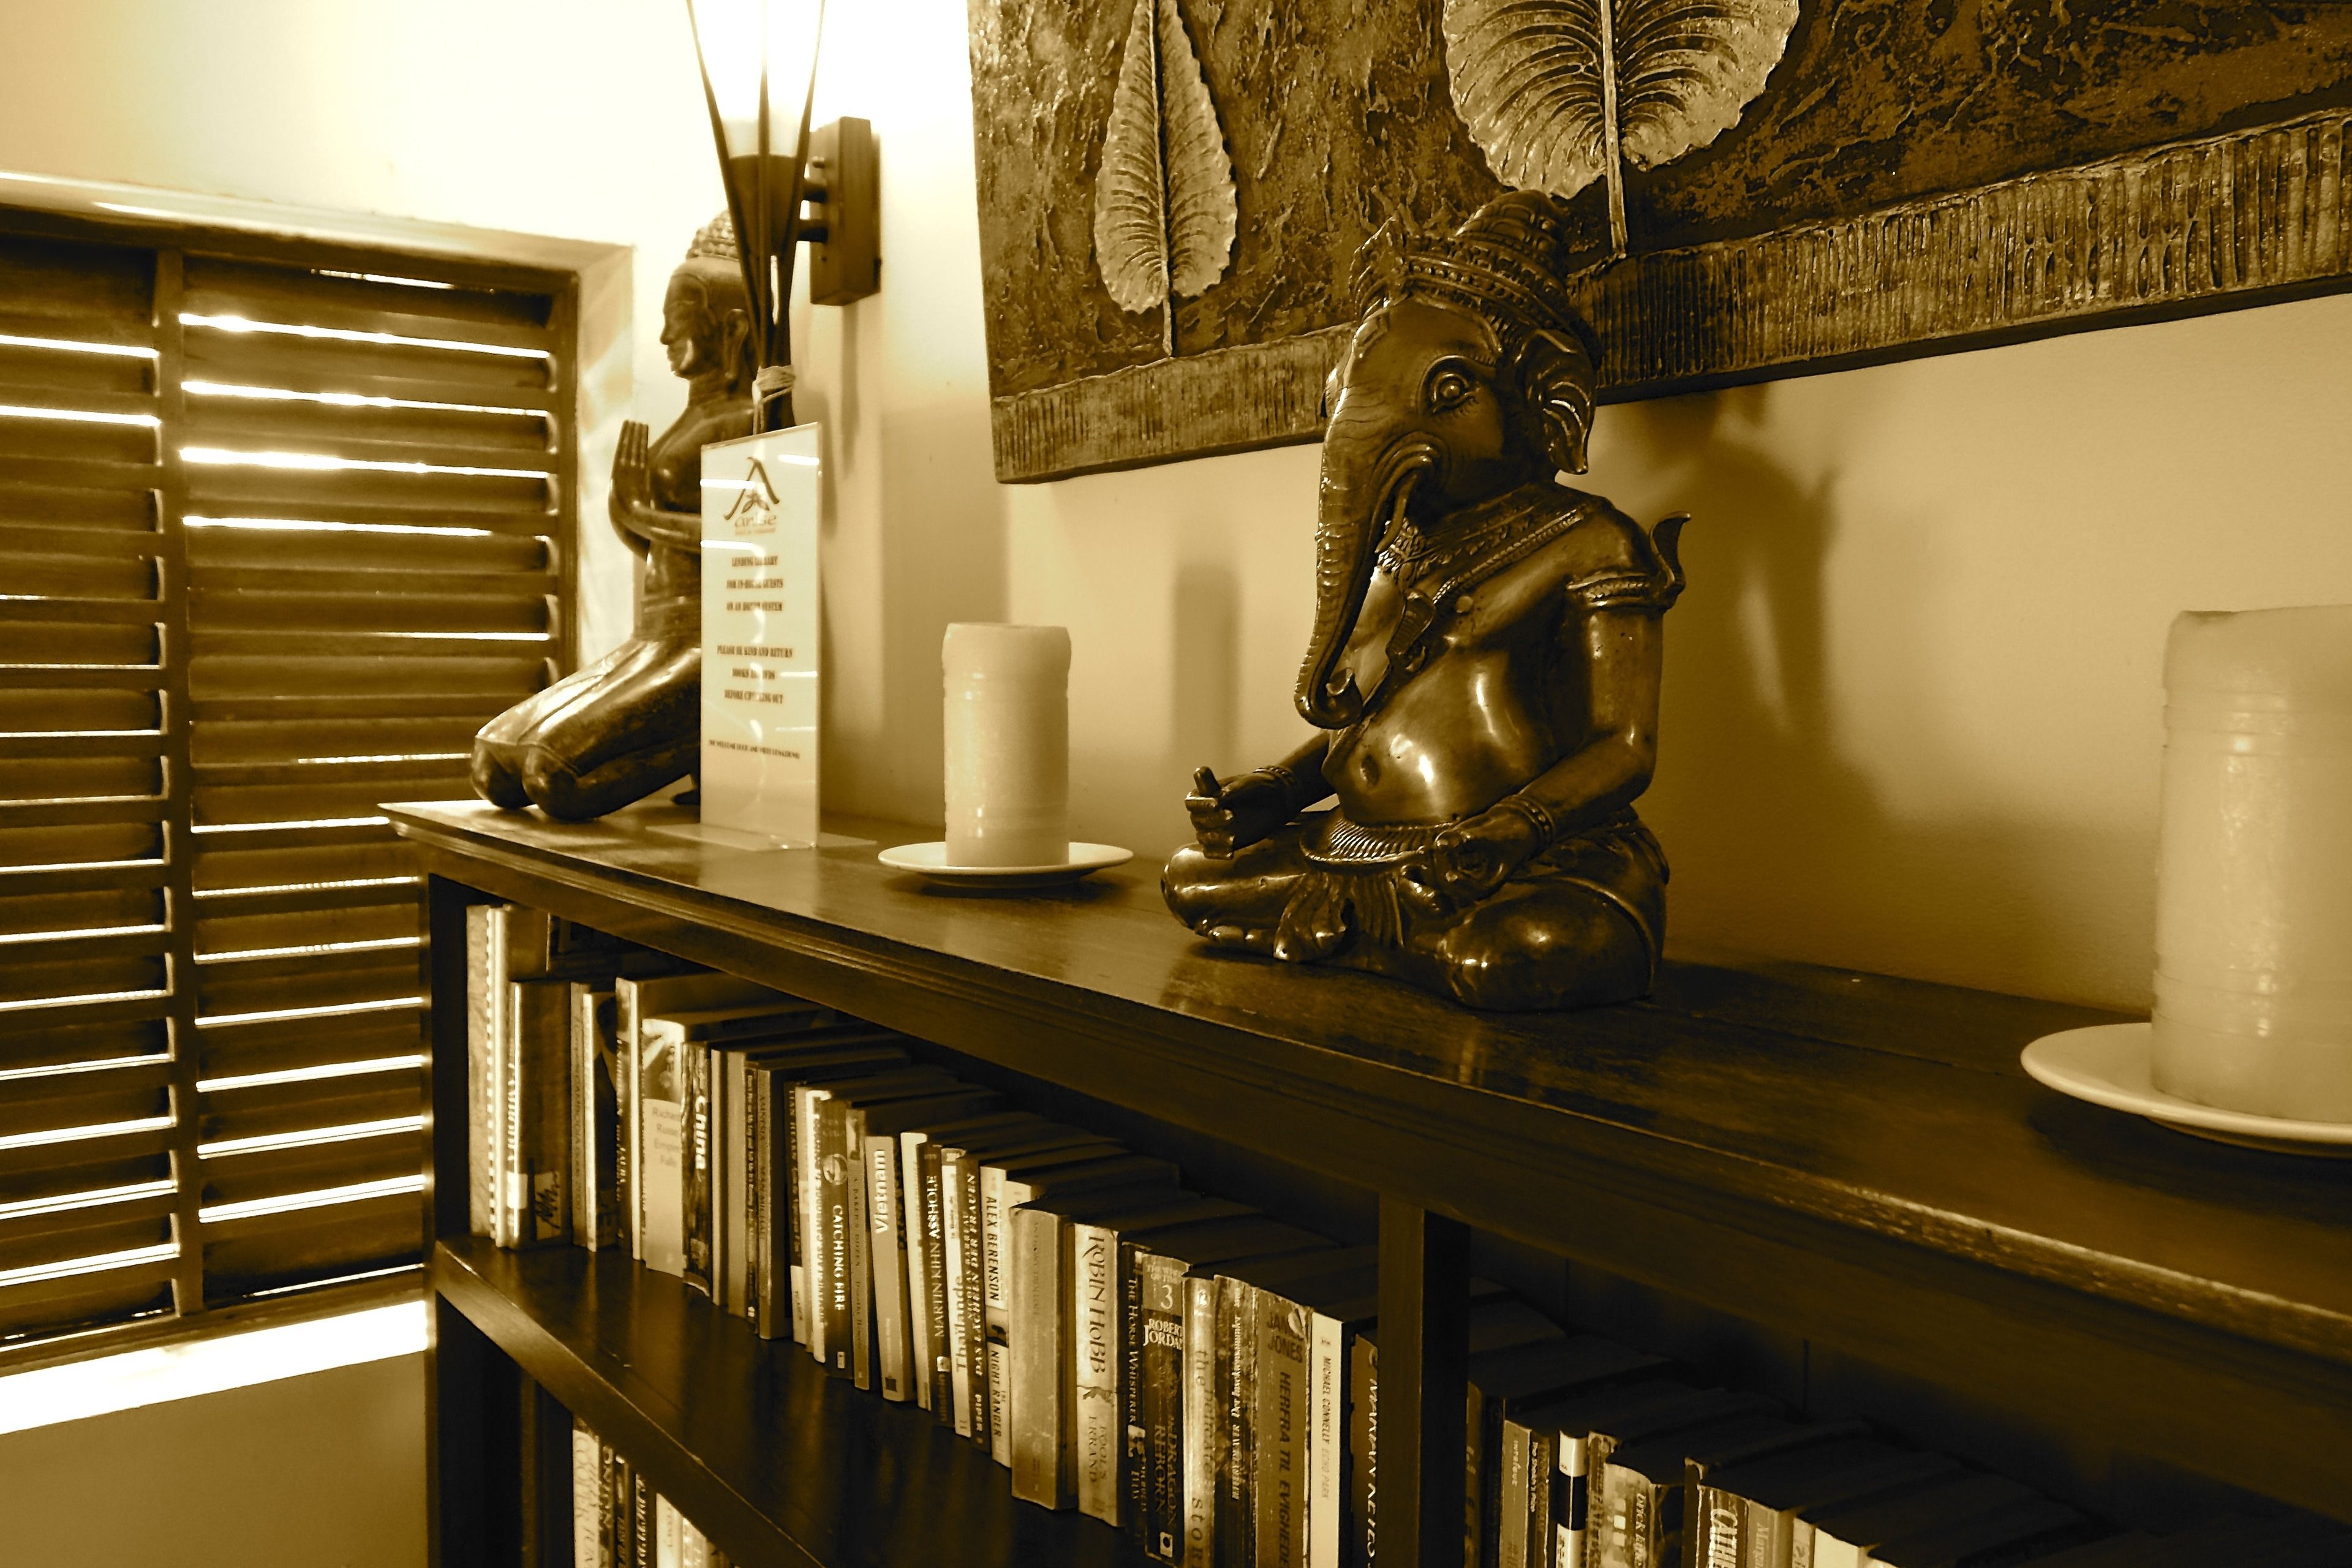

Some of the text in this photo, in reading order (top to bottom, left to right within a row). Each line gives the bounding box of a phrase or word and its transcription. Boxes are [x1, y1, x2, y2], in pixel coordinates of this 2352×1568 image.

[744, 691, 771, 703] CHEING
[696, 1095, 707, 1169] China
[874, 1149, 889, 1234] Vietnam
[832, 1205, 845, 1278] CATCHING
[930, 1242, 941, 1279] KIHN
[986, 1196, 1000, 1301] ALEX BERENSON
[932, 1283, 944, 1338] MARTIN
[952, 1276, 966, 1373] Thaïlande
[1148, 1318, 1182, 1337] ROBERT
[1161, 1284, 1174, 1310] 3
[1266, 1311, 1305, 1341] JAM
[1128, 1278, 1140, 1423] THE HORSE WHISPERER
[1195, 1349, 1209, 1387] the
[1322, 1355, 1331, 1394] MICHAEL
[990, 1350, 1002, 1438] NIGHT RANGER
[1231, 1398, 1241, 1418] Der
[1322, 1398, 1331, 1445] CONNELLY
[1088, 1416, 1098, 1483] ERRAND
[1154, 1424, 1166, 1514] REBORN
[1167, 1433, 1177, 1525] DRAGON
[1278, 1371, 1291, 1568] HERFRA TIL EVIGHEDE
